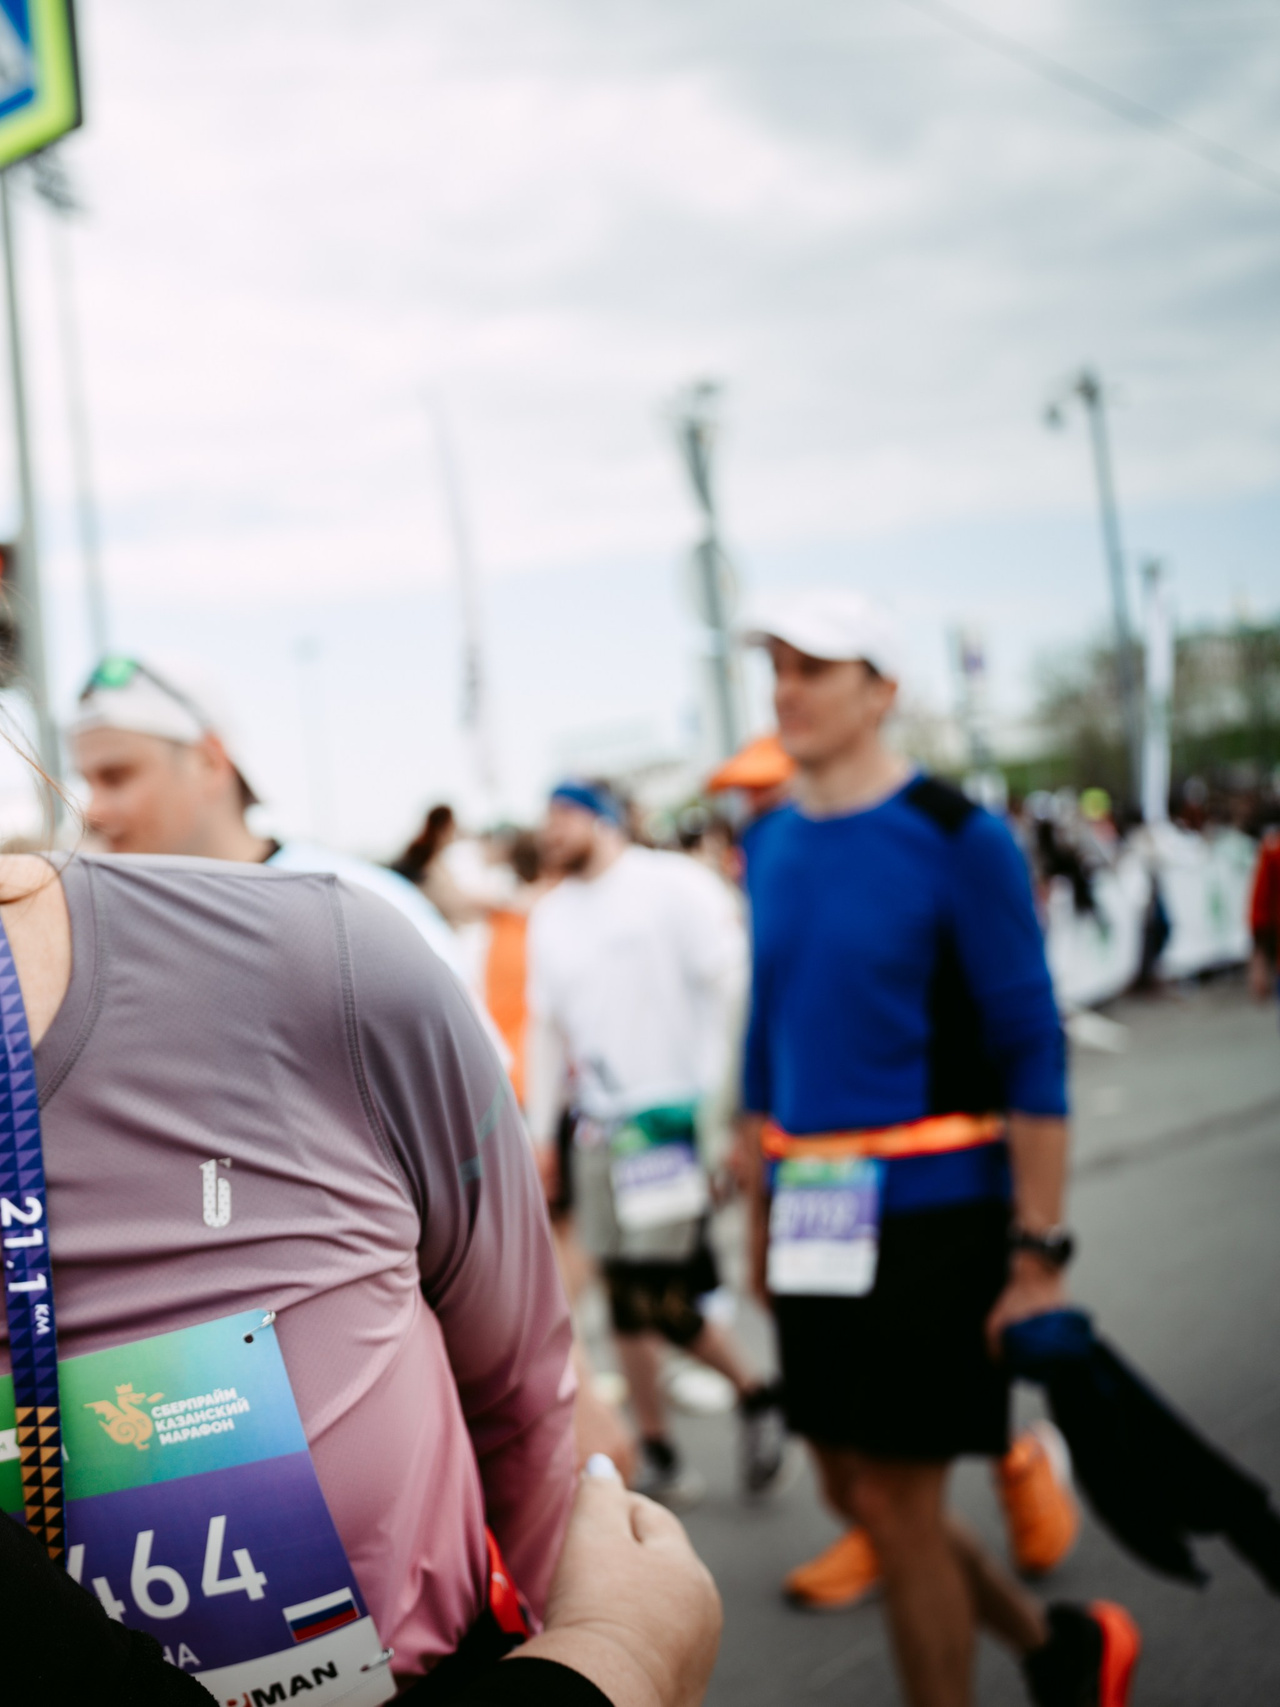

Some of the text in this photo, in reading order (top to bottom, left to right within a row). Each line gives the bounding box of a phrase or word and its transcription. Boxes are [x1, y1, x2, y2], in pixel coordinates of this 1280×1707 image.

[0, 1197, 47, 1292] 21.1
[151, 1387, 237, 1419] СБЕРПРАЙМ
[155, 1396, 250, 1432] КАЗАНСКИЙ
[159, 1418, 235, 1446] МАРАФОН
[228, 1660, 338, 1707] MAN
